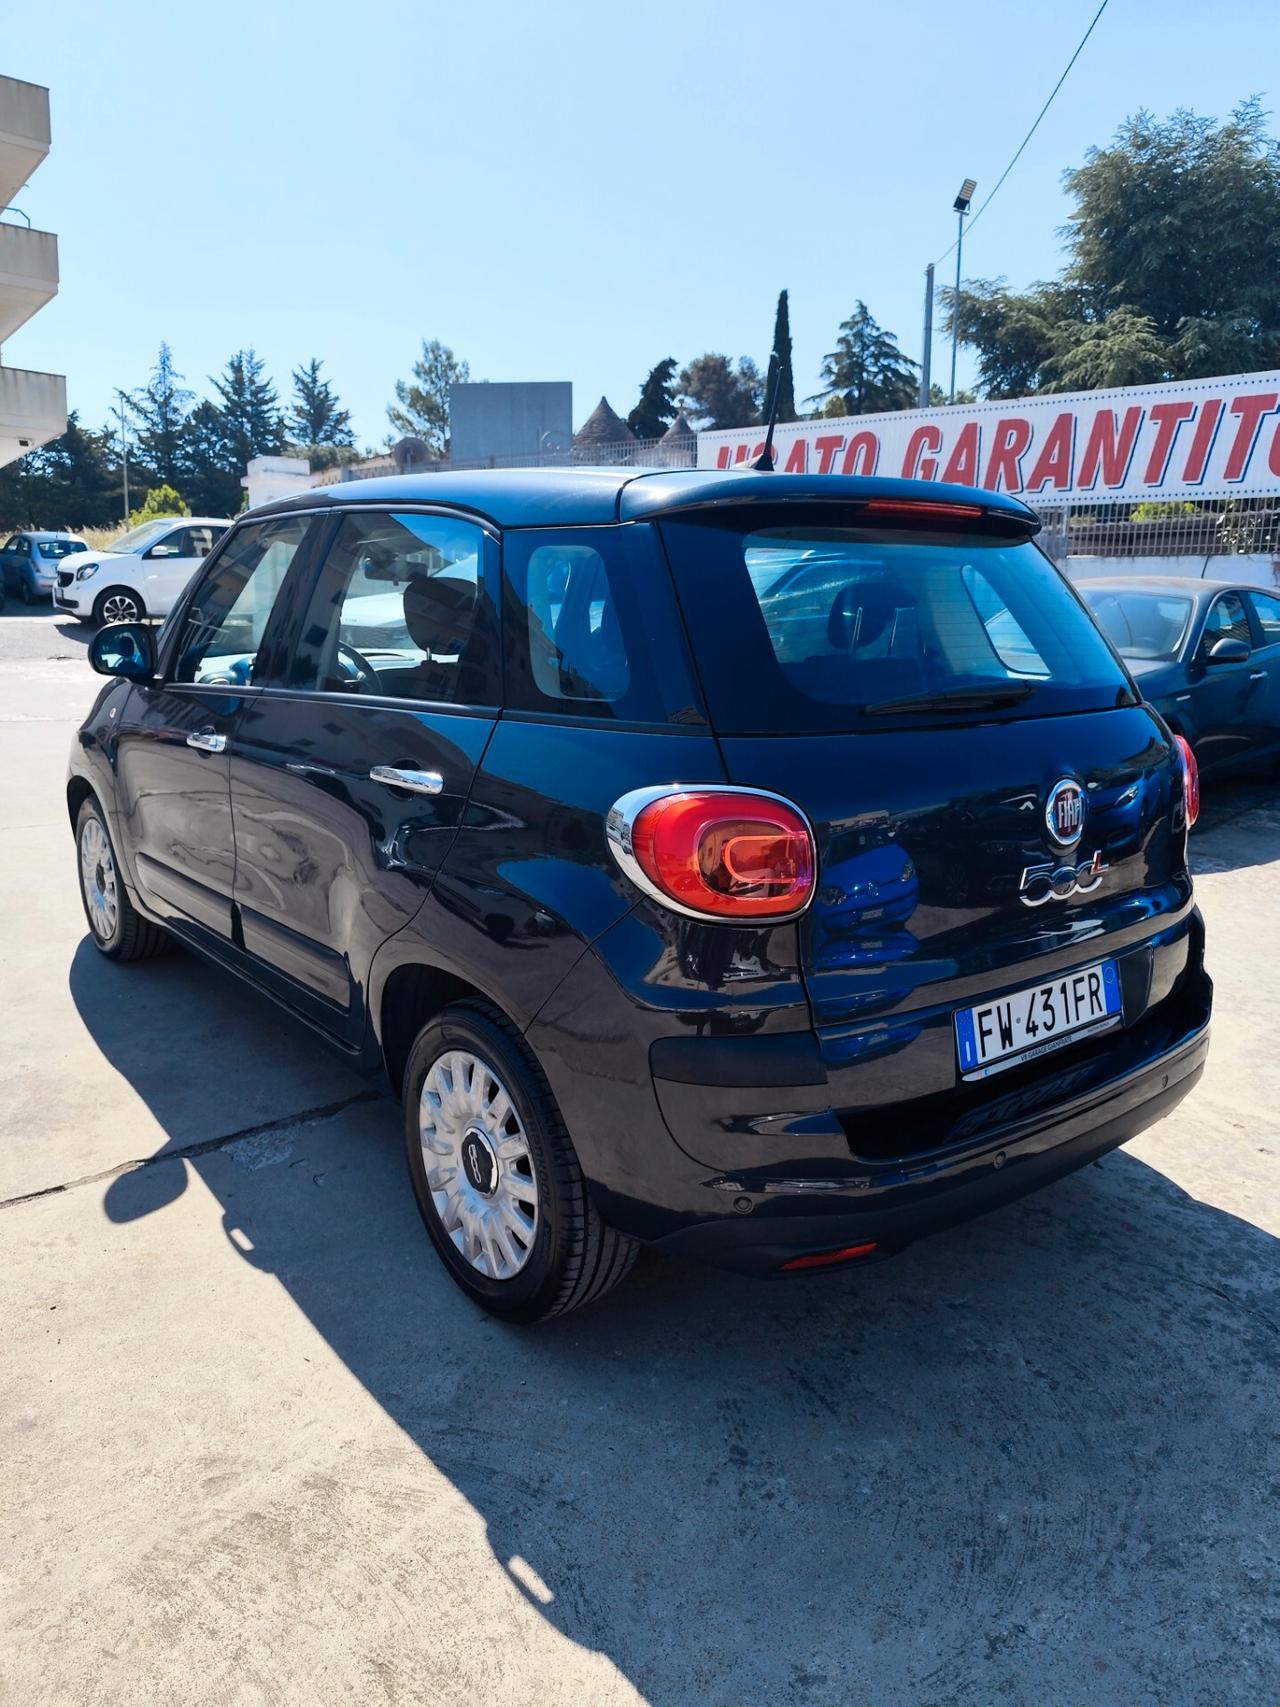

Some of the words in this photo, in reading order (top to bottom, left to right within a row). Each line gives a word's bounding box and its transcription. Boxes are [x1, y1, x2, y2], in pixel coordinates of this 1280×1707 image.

[1057, 797, 1083, 830] FIAT
[976, 1002, 1014, 1058] FW
[1025, 972, 1103, 1038] 431FR
